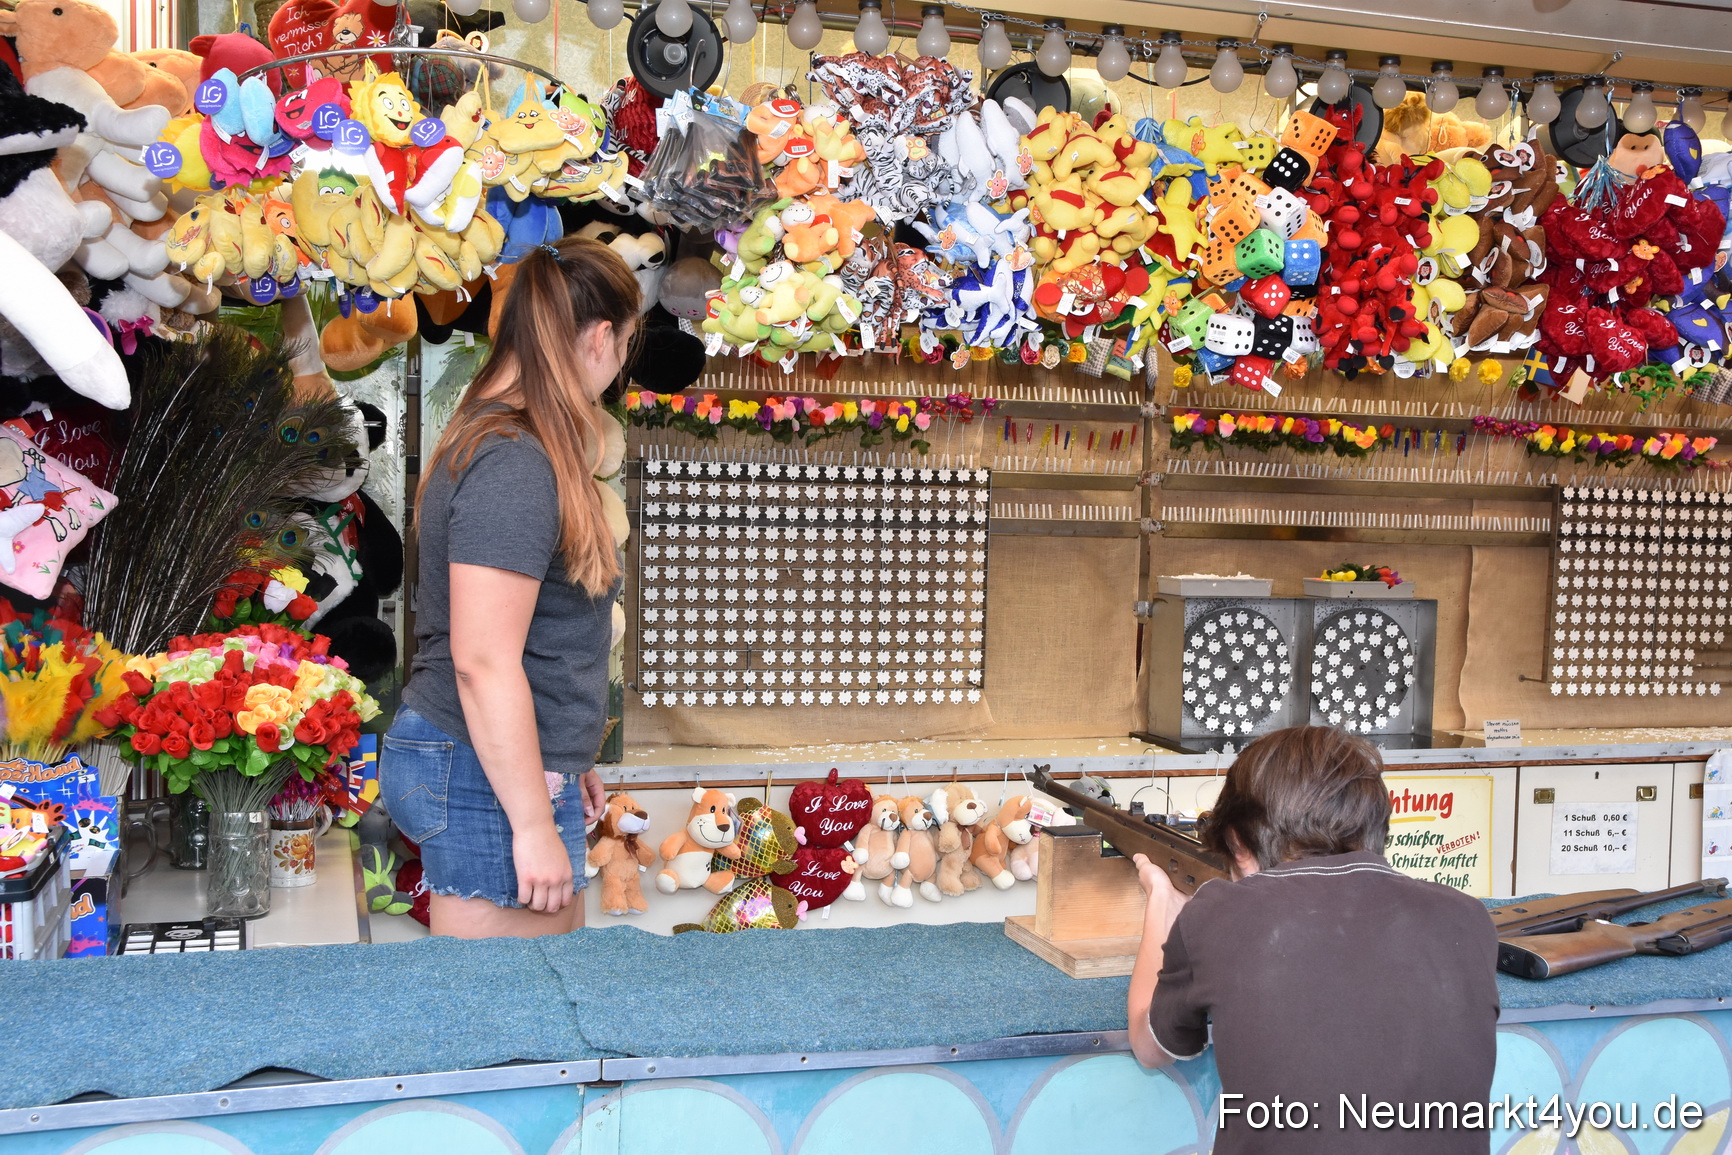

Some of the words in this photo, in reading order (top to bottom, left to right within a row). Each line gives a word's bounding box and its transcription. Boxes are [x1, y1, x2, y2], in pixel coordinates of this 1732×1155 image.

[285, 6, 310, 24] Ich
[274, 20, 329, 45] vermisse
[1624, 188, 1653, 218] You
[1564, 321, 1586, 339] Yo
[1600, 319, 1617, 329] I
[1618, 328, 1645, 352] Love
[1608, 336, 1631, 359] You
[58, 420, 101, 445] Love
[805, 796, 823, 813] I
[829, 795, 868, 812] Love
[1389, 788, 1454, 819] htung
[820, 818, 854, 835] You
[1603, 814, 1620, 822] 0,60
[1395, 830, 1444, 849] schießen
[1436, 831, 1481, 854] VERBOTEN!
[1575, 829, 1600, 837] Schuß
[1573, 844, 1598, 852] Schuß
[802, 861, 841, 880] Love
[1391, 853, 1438, 870] Schütze
[1440, 853, 1478, 870] haftet
[788, 881, 824, 897] You
